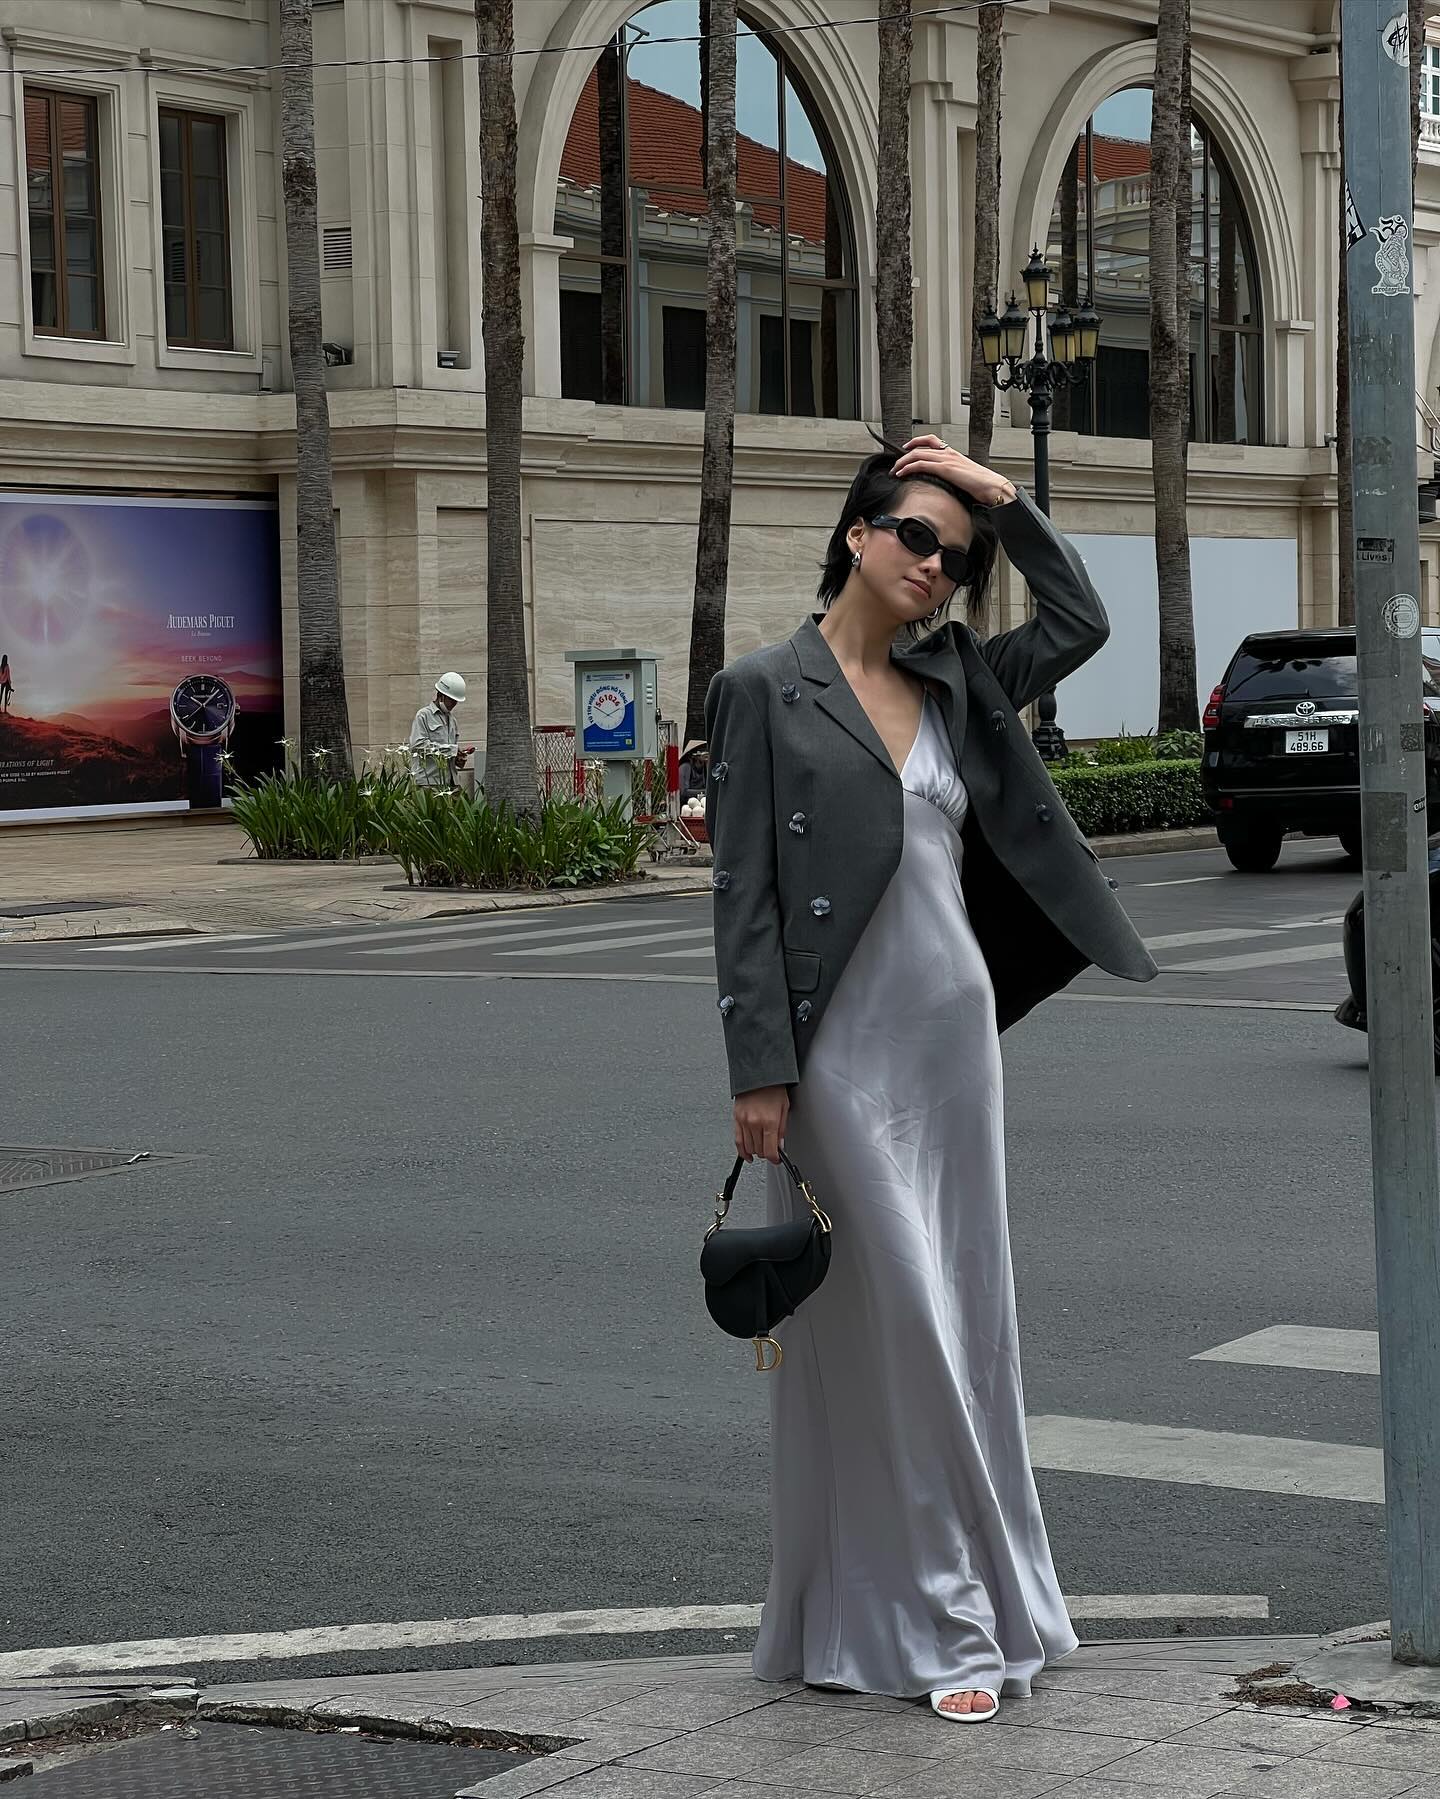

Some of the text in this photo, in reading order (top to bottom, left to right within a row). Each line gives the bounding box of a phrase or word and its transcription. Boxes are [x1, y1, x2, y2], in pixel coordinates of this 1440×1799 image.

[166, 613, 235, 629] AUDEMARS PIGUET
[595, 694, 621, 708] SG1026
[1297, 731, 1316, 741] 51H
[1290, 741, 1324, 752] 489.66
[36, 759, 54, 767] LIGHT
[752, 1337, 783, 1371] D
